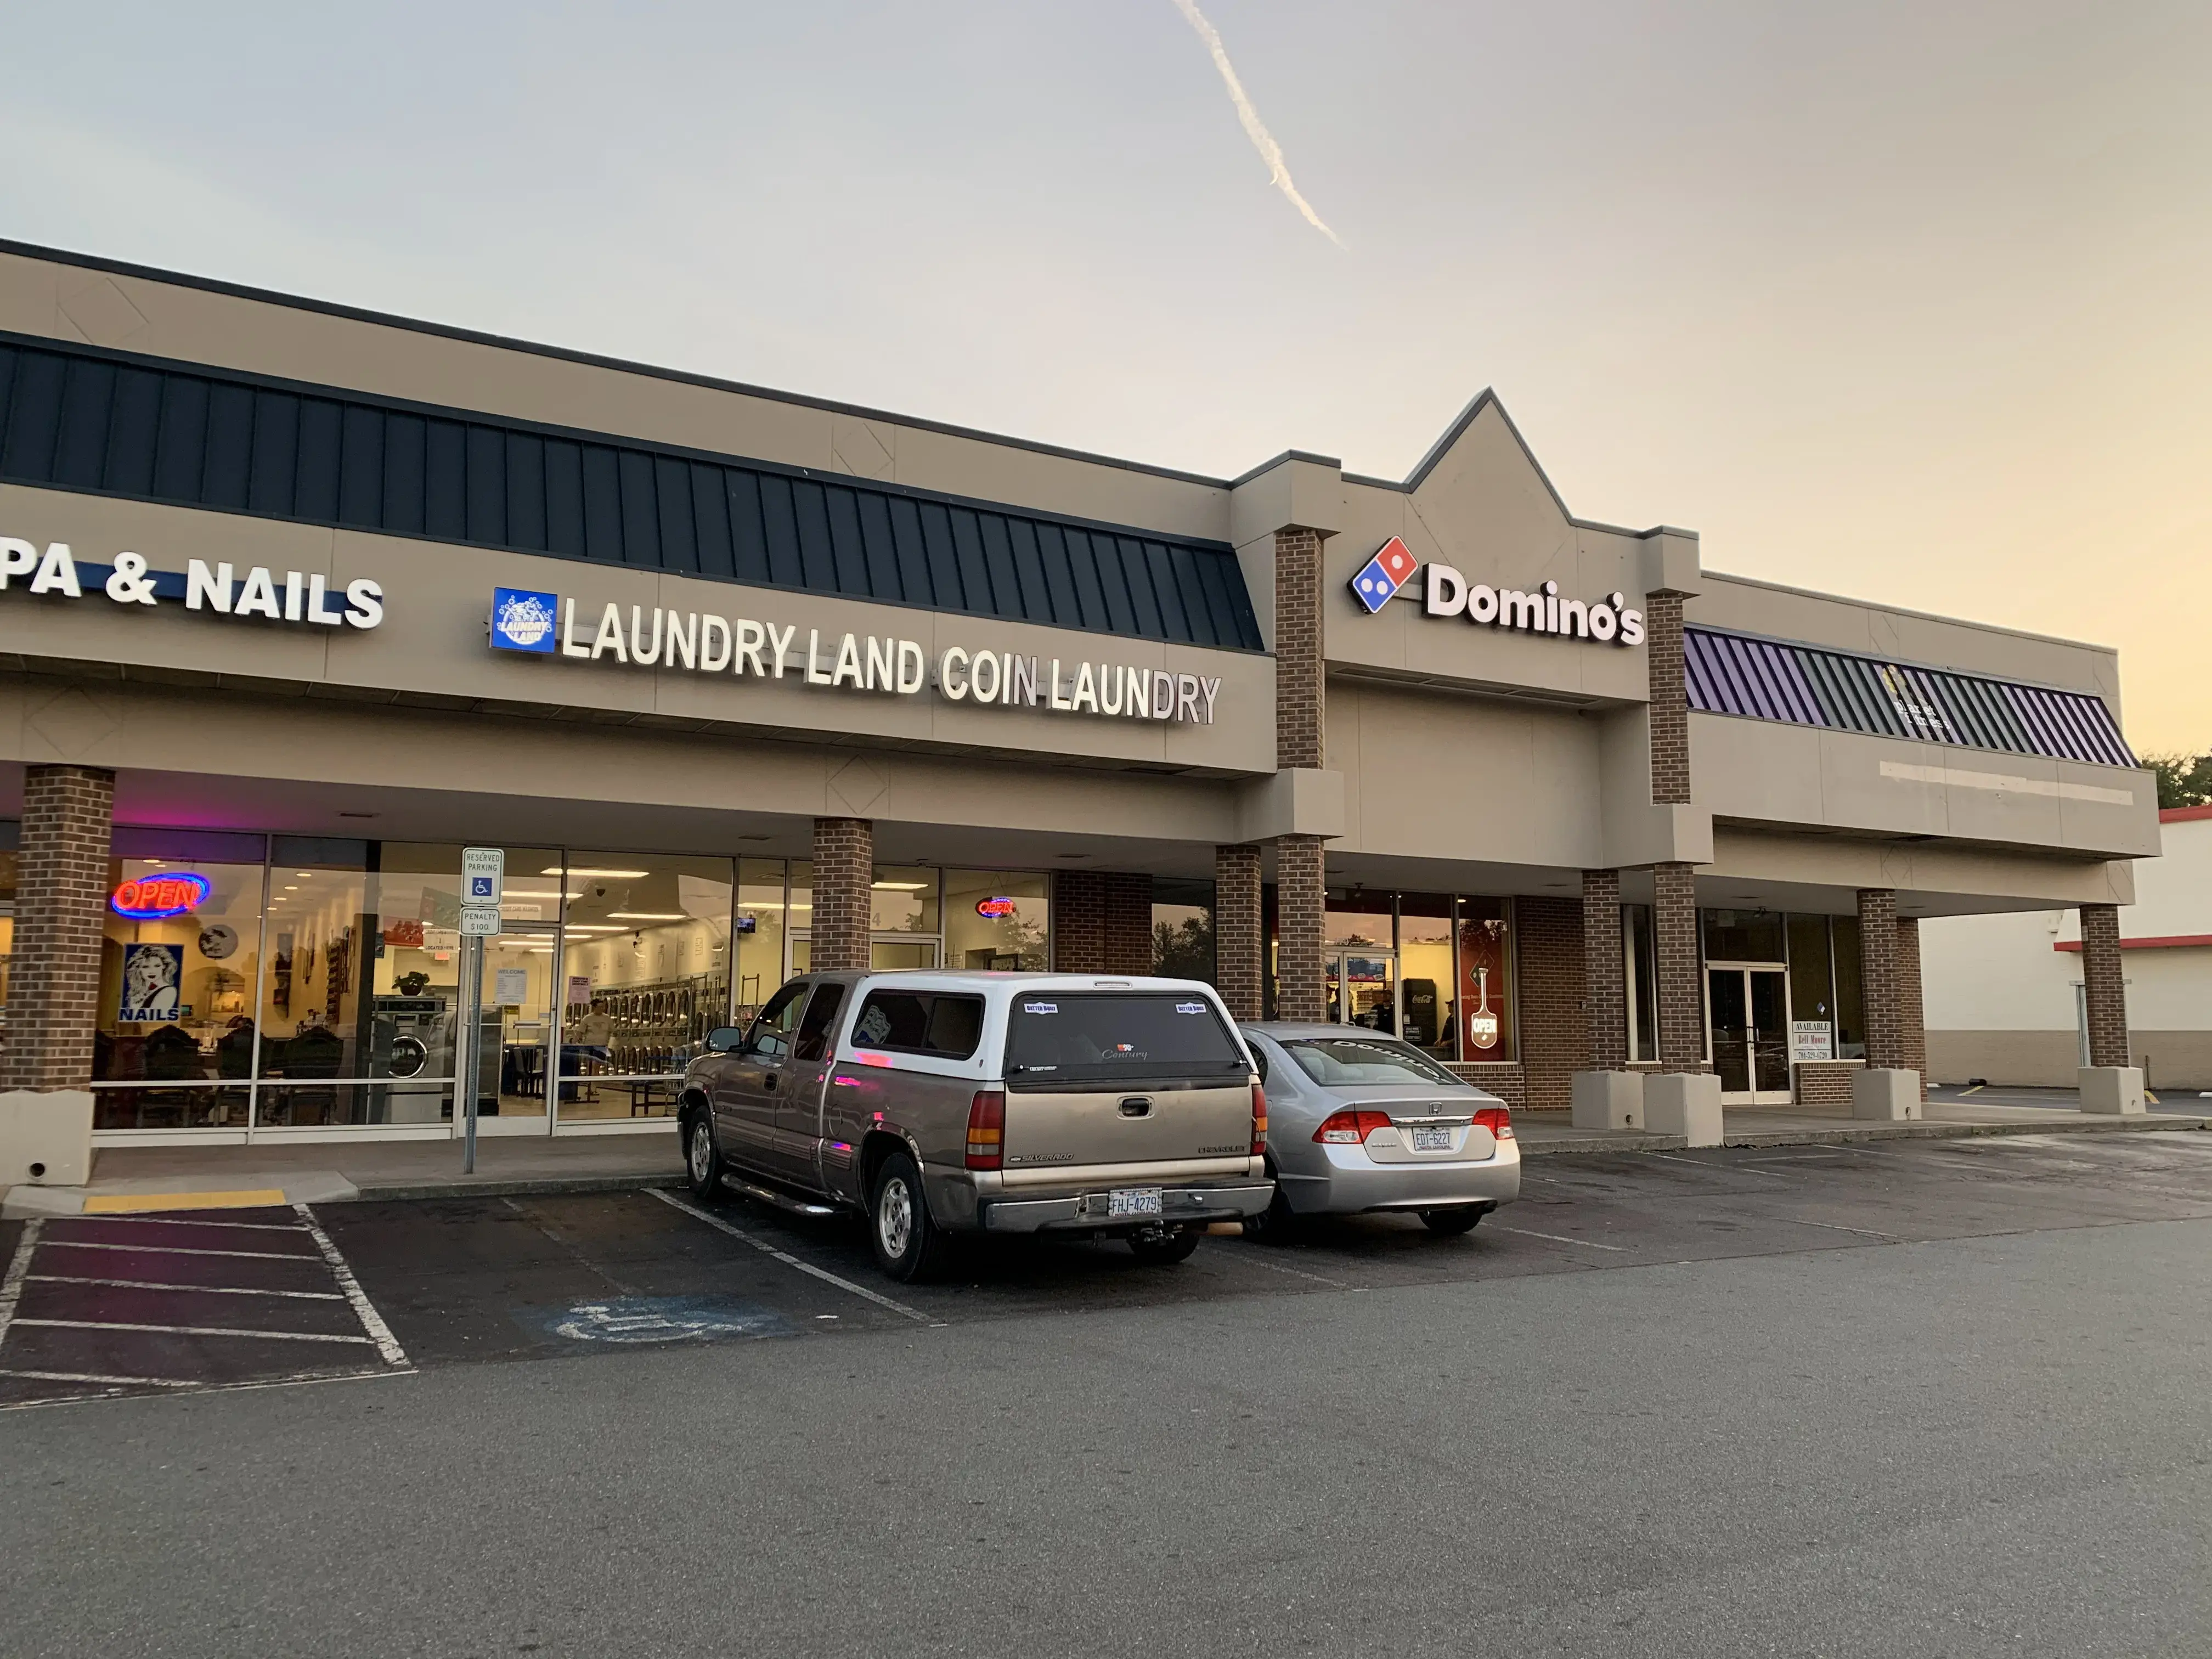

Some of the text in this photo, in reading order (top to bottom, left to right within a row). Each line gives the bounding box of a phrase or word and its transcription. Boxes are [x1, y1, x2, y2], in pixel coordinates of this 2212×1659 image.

[105, 551, 157, 605] &
[185, 558, 383, 629] NAILS
[1424, 562, 1645, 646] Domino's
[500, 620, 549, 632] LAUNDRY
[513, 631, 542, 641] LAND
[562, 597, 1222, 724] LAUNDRY LAND COIN LAUNDRY
[466, 854, 500, 862] RESERVED
[114, 879, 202, 910] OPEN
[978, 901, 1013, 913] OPEN
[119, 1008, 179, 1022] NAILS
[1473, 1018, 1497, 1034] OPEN
[1796, 1022, 1829, 1031] AVAILABLE
[1798, 1034, 1809, 1044] Bell
[1102, 1049, 1148, 1060] Century
[1416, 1132, 1451, 1146] EDT-6227
[1198, 1145, 1245, 1154] CHEVROLET
[1021, 1153, 1074, 1163] SILVERADO
[1113, 1197, 1156, 1213] FHJ-4279
